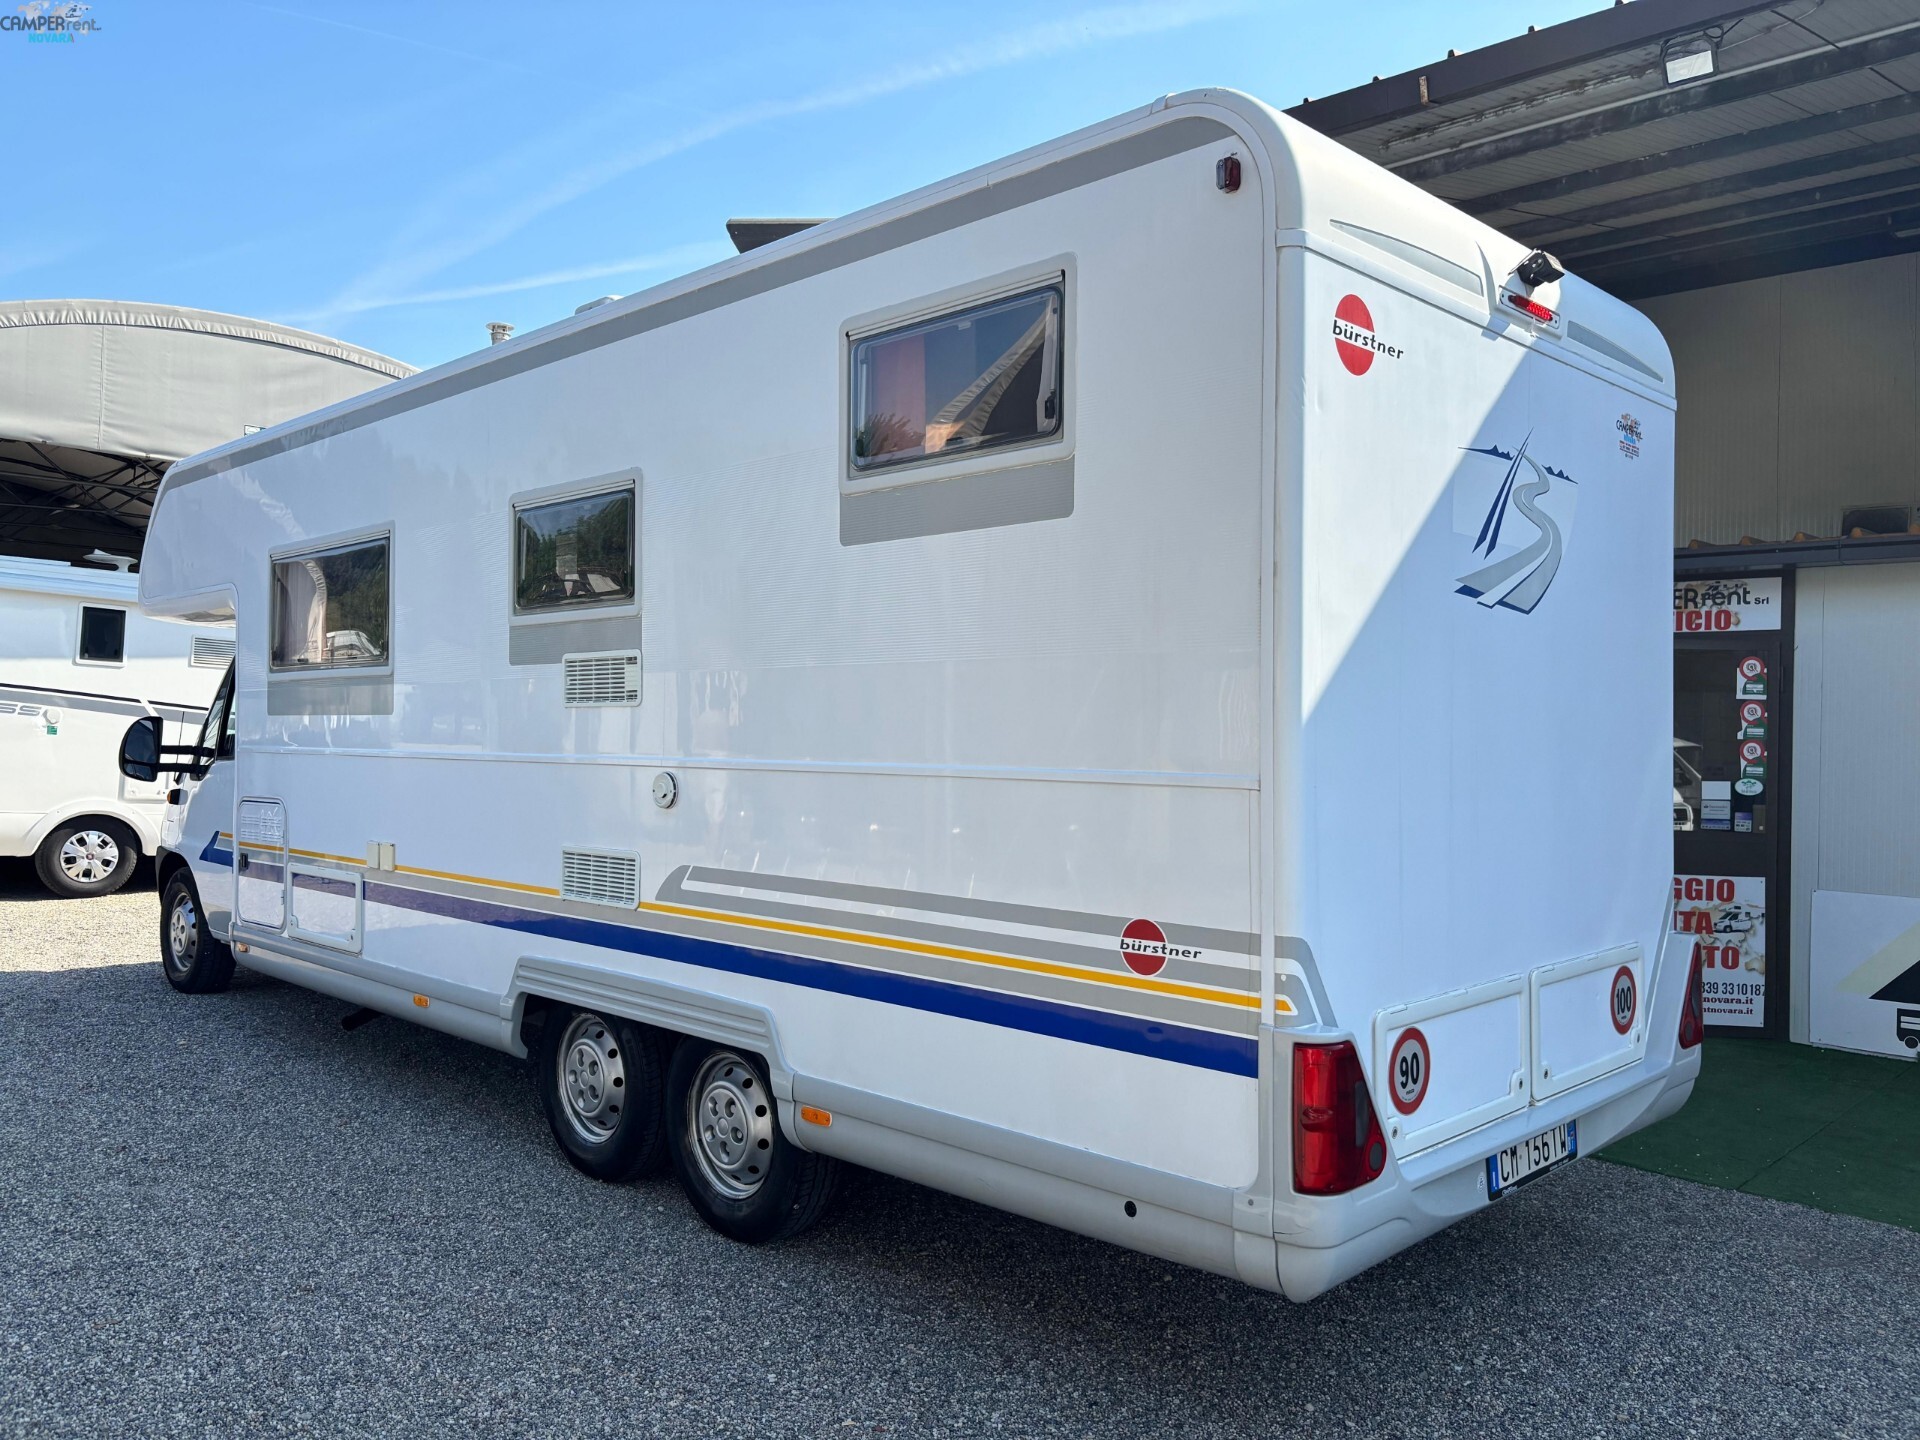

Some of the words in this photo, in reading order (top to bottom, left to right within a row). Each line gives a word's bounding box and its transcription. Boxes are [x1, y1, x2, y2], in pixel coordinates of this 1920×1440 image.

[1332, 319, 1404, 359] bürstner
[1754, 597, 1769, 605] Srl
[1673, 609, 1732, 631] ICIO
[1120, 938, 1202, 959] bürstner
[1702, 945, 1740, 970] TO
[1616, 985, 1632, 1015] 100
[1399, 1051, 1420, 1089] 90
[1500, 1145, 1519, 1182] CM
[1525, 1124, 1567, 1171] 156TW
